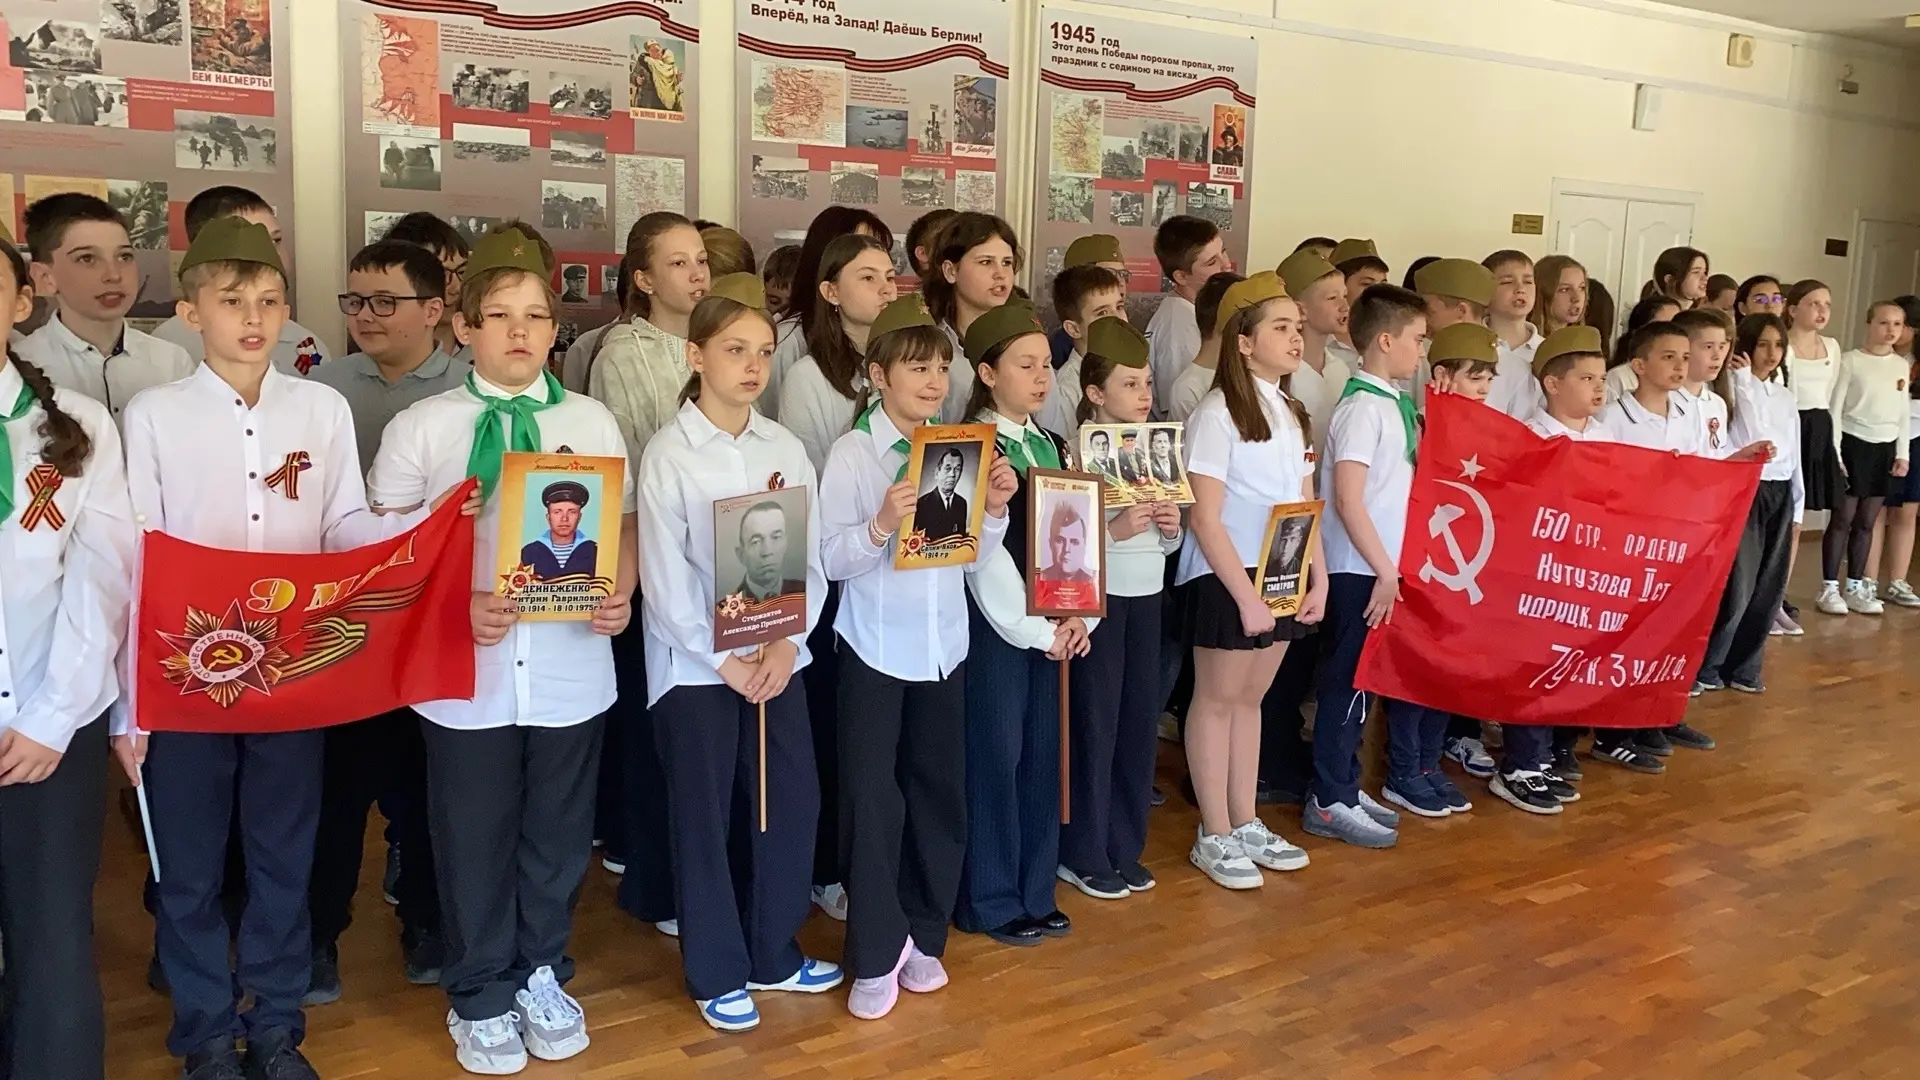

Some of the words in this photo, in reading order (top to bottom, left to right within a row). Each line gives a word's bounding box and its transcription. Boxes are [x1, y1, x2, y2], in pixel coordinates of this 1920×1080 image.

[812, 0, 836, 11] год
[751, 4, 808, 24] Вперёд,
[813, 13, 830, 24] на
[834, 15, 879, 32] Запад!
[883, 21, 927, 37] Даёшь
[931, 27, 982, 43] Берлин!
[1050, 22, 1095, 43] 1945
[1101, 37, 1120, 48] год
[1051, 55, 1098, 68] праздник
[1101, 61, 1107, 69] с
[1109, 63, 1151, 74] сединою
[1153, 67, 1165, 76] на
[1166, 71, 1198, 80] висках
[1052, 41, 1073, 52] Этот
[1076, 45, 1099, 56] день
[1101, 48, 1138, 60] Победы
[1140, 54, 1179, 66] порохом
[1181, 59, 1215, 72] пропах,
[1217, 64, 1235, 73] этот
[215, 74, 273, 87] НАСМЕРТЬ!
[1216, 166, 1237, 176] СЛАВА
[1532, 506, 1571, 542] 150
[1575, 523, 1607, 551] СТР.
[1624, 533, 1688, 564] ОРДЕНА
[246, 578, 296, 613] 9
[1518, 593, 1593, 629] ИДРИЦК.
[191, 632, 259, 680] ОТЕЧЕСТВЕННАЯ
[1610, 653, 1627, 688] 3
